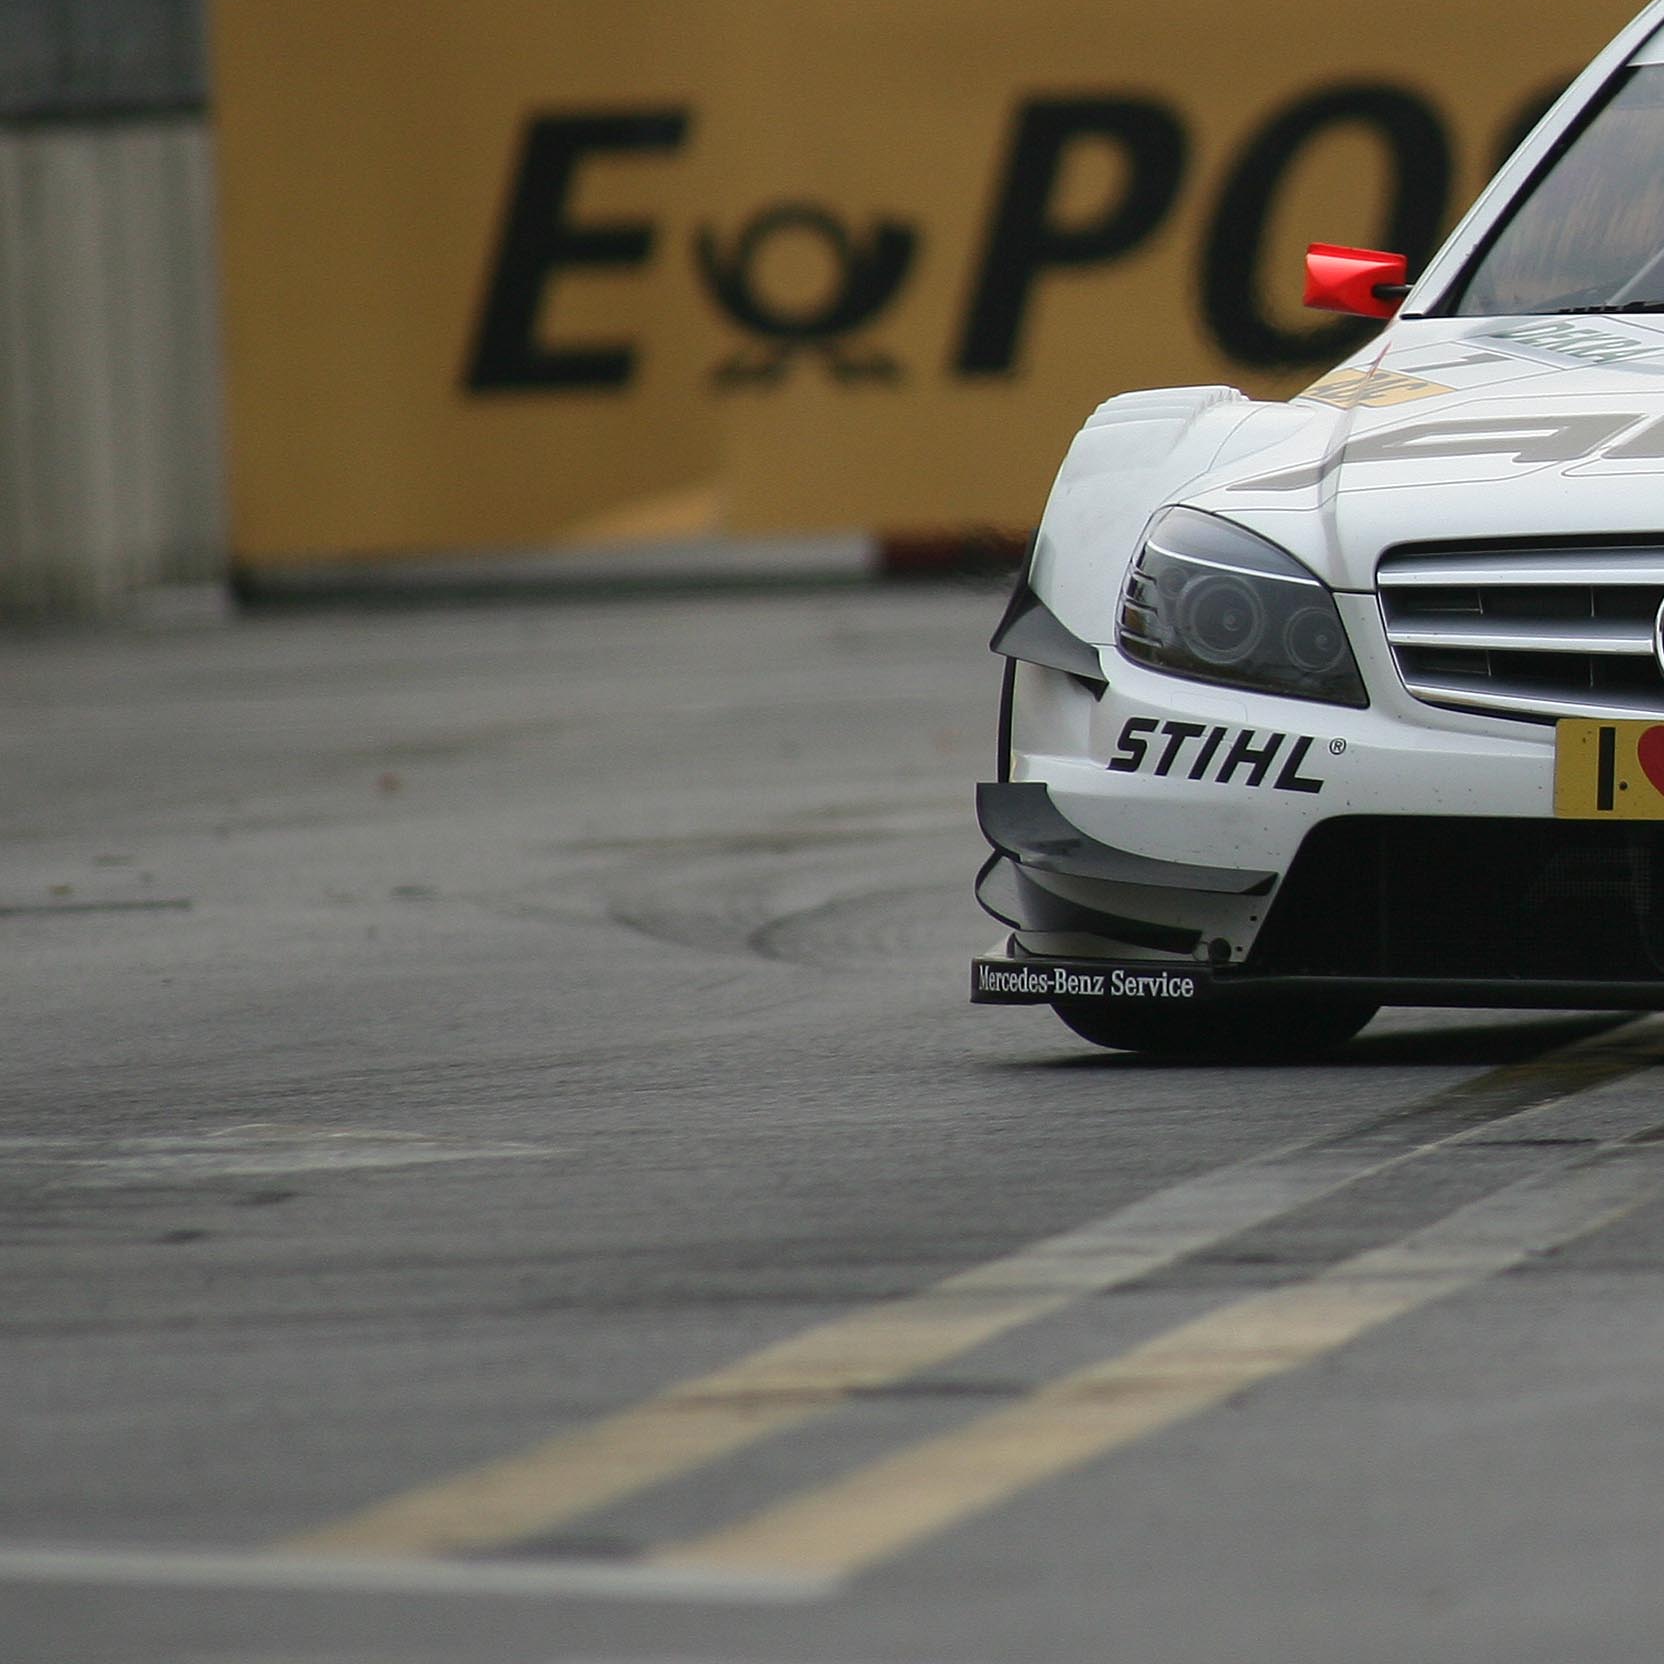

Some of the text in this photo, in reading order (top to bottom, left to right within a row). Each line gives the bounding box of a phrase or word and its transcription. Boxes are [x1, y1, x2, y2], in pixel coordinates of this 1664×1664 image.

[950, 78, 1577, 382] PO
[1490, 320, 1664, 364] DEKRA
[979, 965, 1195, 998] Mercedes-Benz Service
